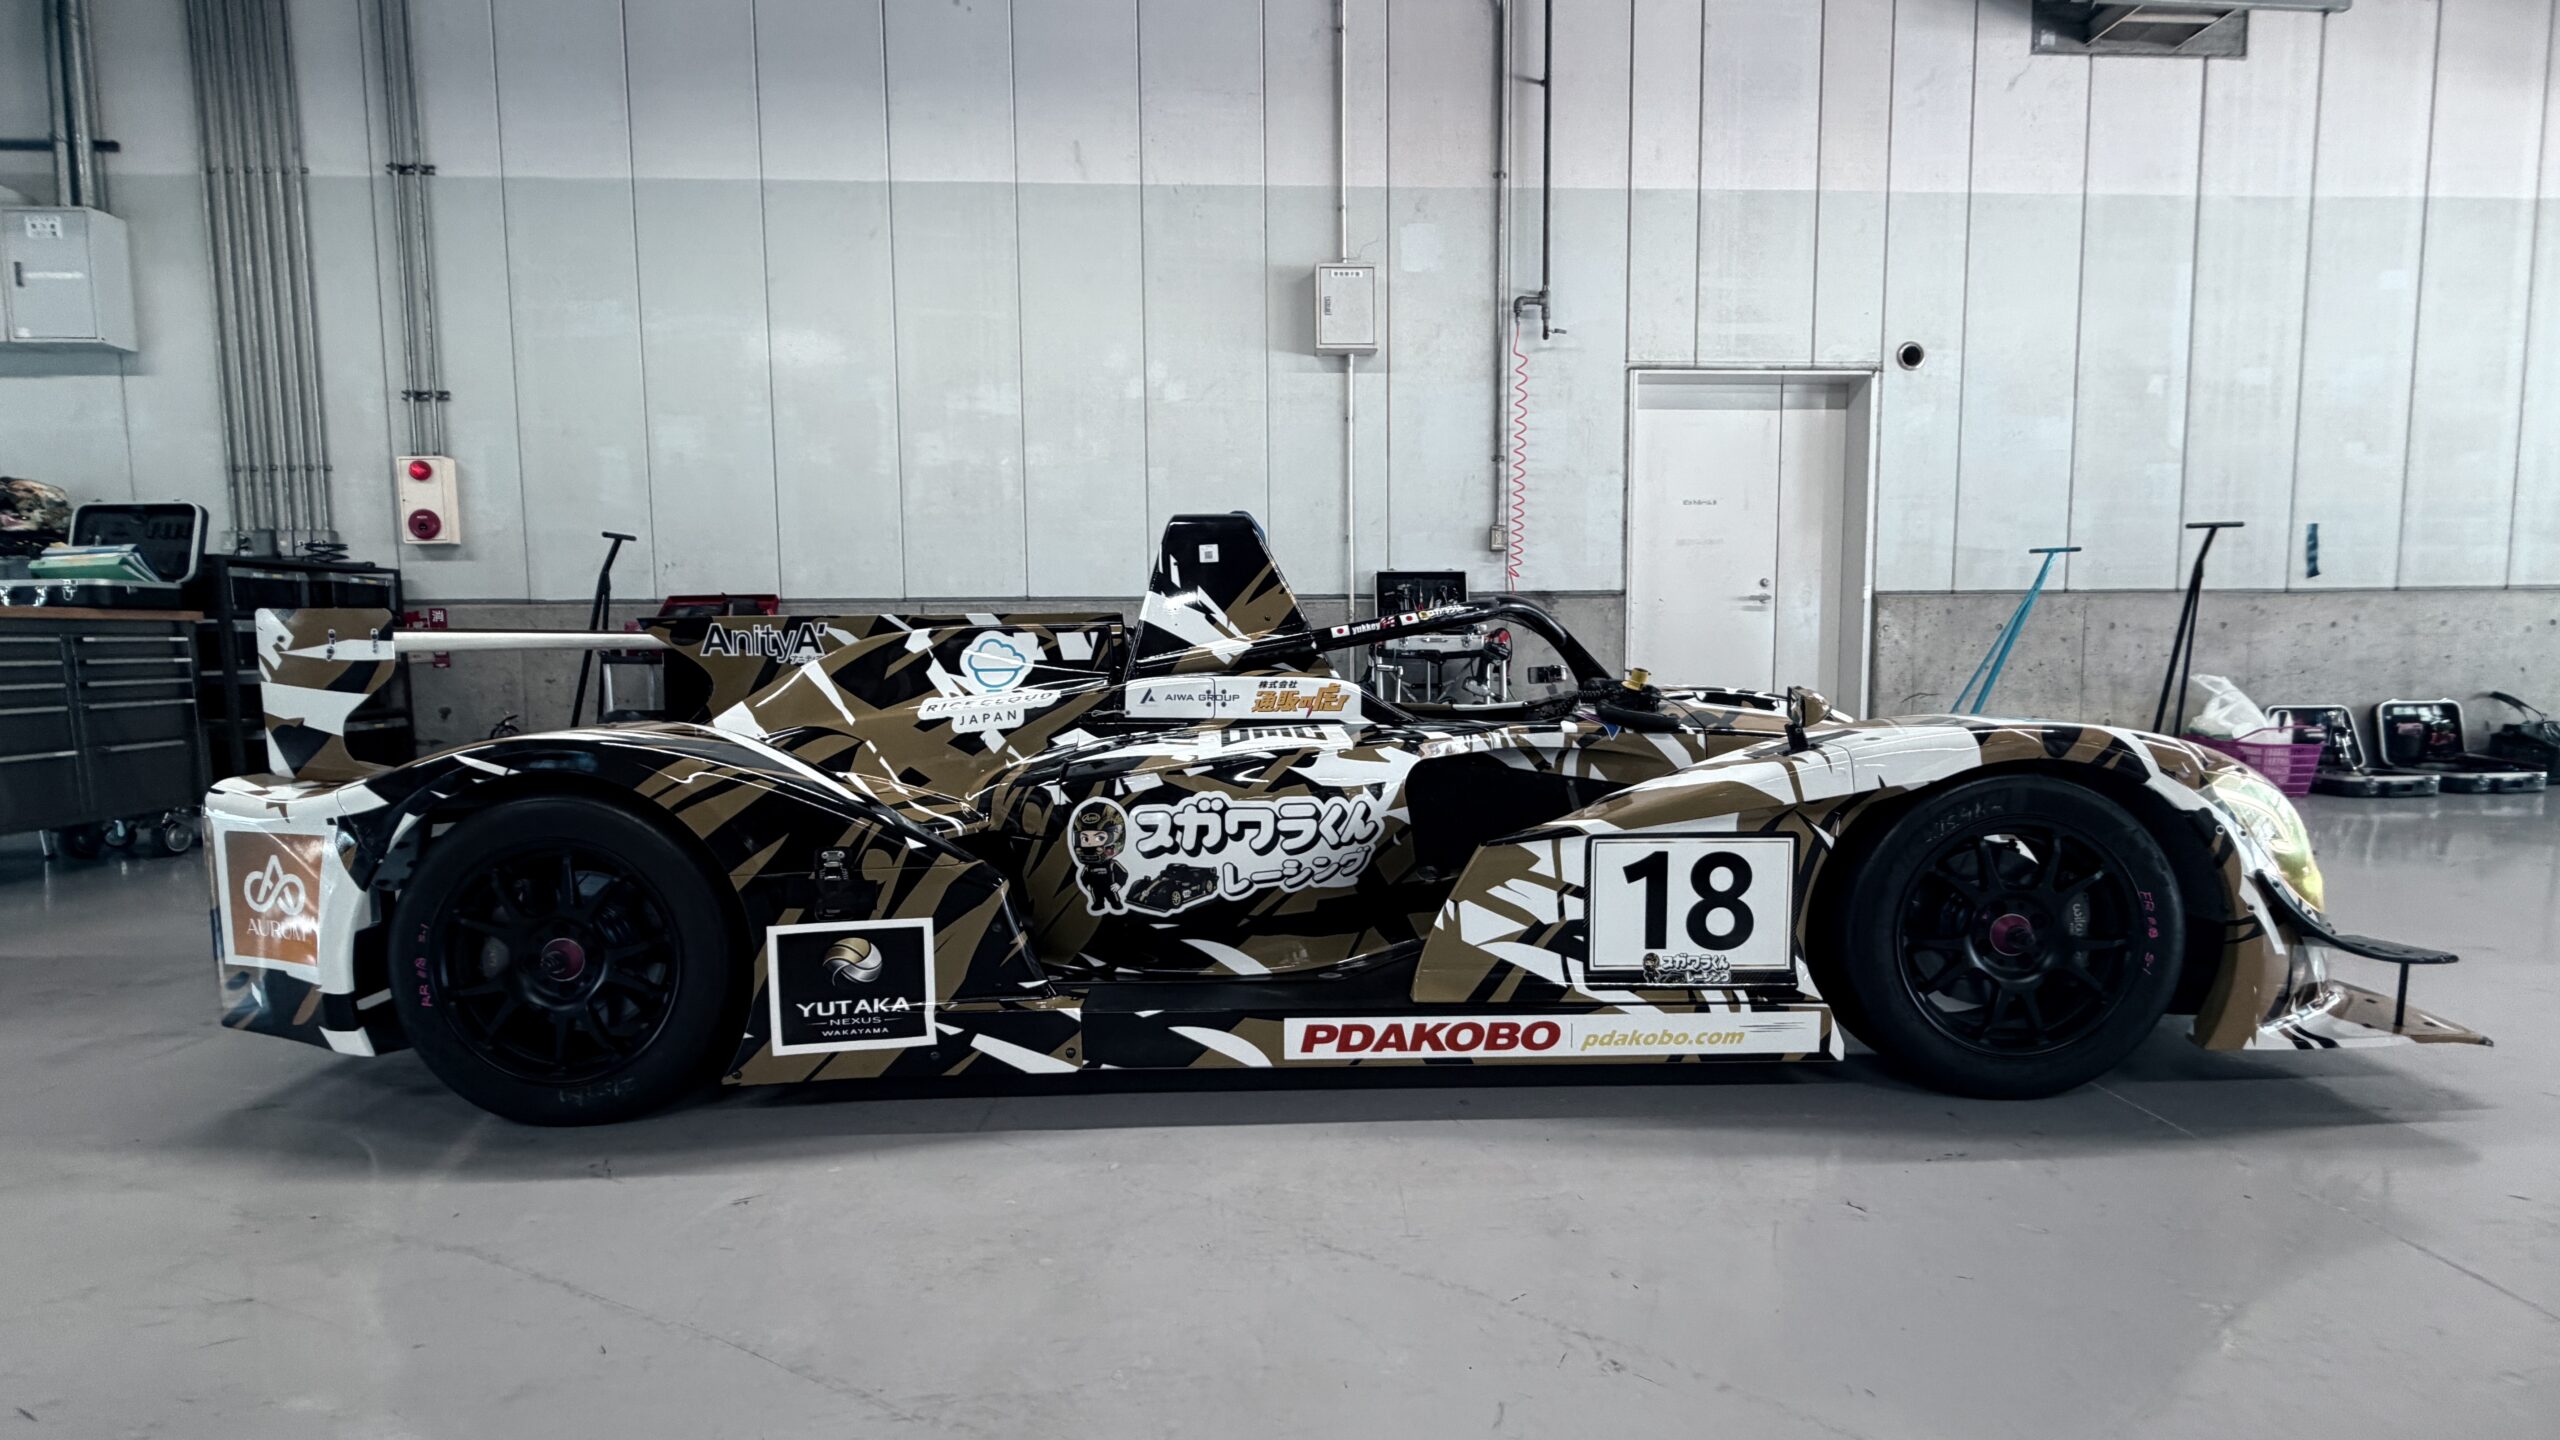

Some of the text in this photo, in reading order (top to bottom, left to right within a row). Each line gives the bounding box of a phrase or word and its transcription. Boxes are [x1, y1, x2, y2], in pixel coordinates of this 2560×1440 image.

[1257, 680, 1298, 689] 株式会社
[1165, 693, 1240, 702] AIWA GROUP
[1251, 682, 1351, 714] 通販の虎
[959, 709, 1018, 726] JAPAN
[1135, 798, 1379, 858] スガワラくん
[1222, 845, 1372, 896] レーシング
[1622, 850, 1754, 951] 18
[1661, 953, 1730, 970] スガワラくん
[796, 997, 911, 1018] YUTAKA
[829, 1016, 882, 1026] NEXUS
[821, 1027, 890, 1037] WAKAYAMA
[1300, 1021, 1561, 1053] PDAKOBO
[1579, 1029, 1746, 1051] pdakobo.com
